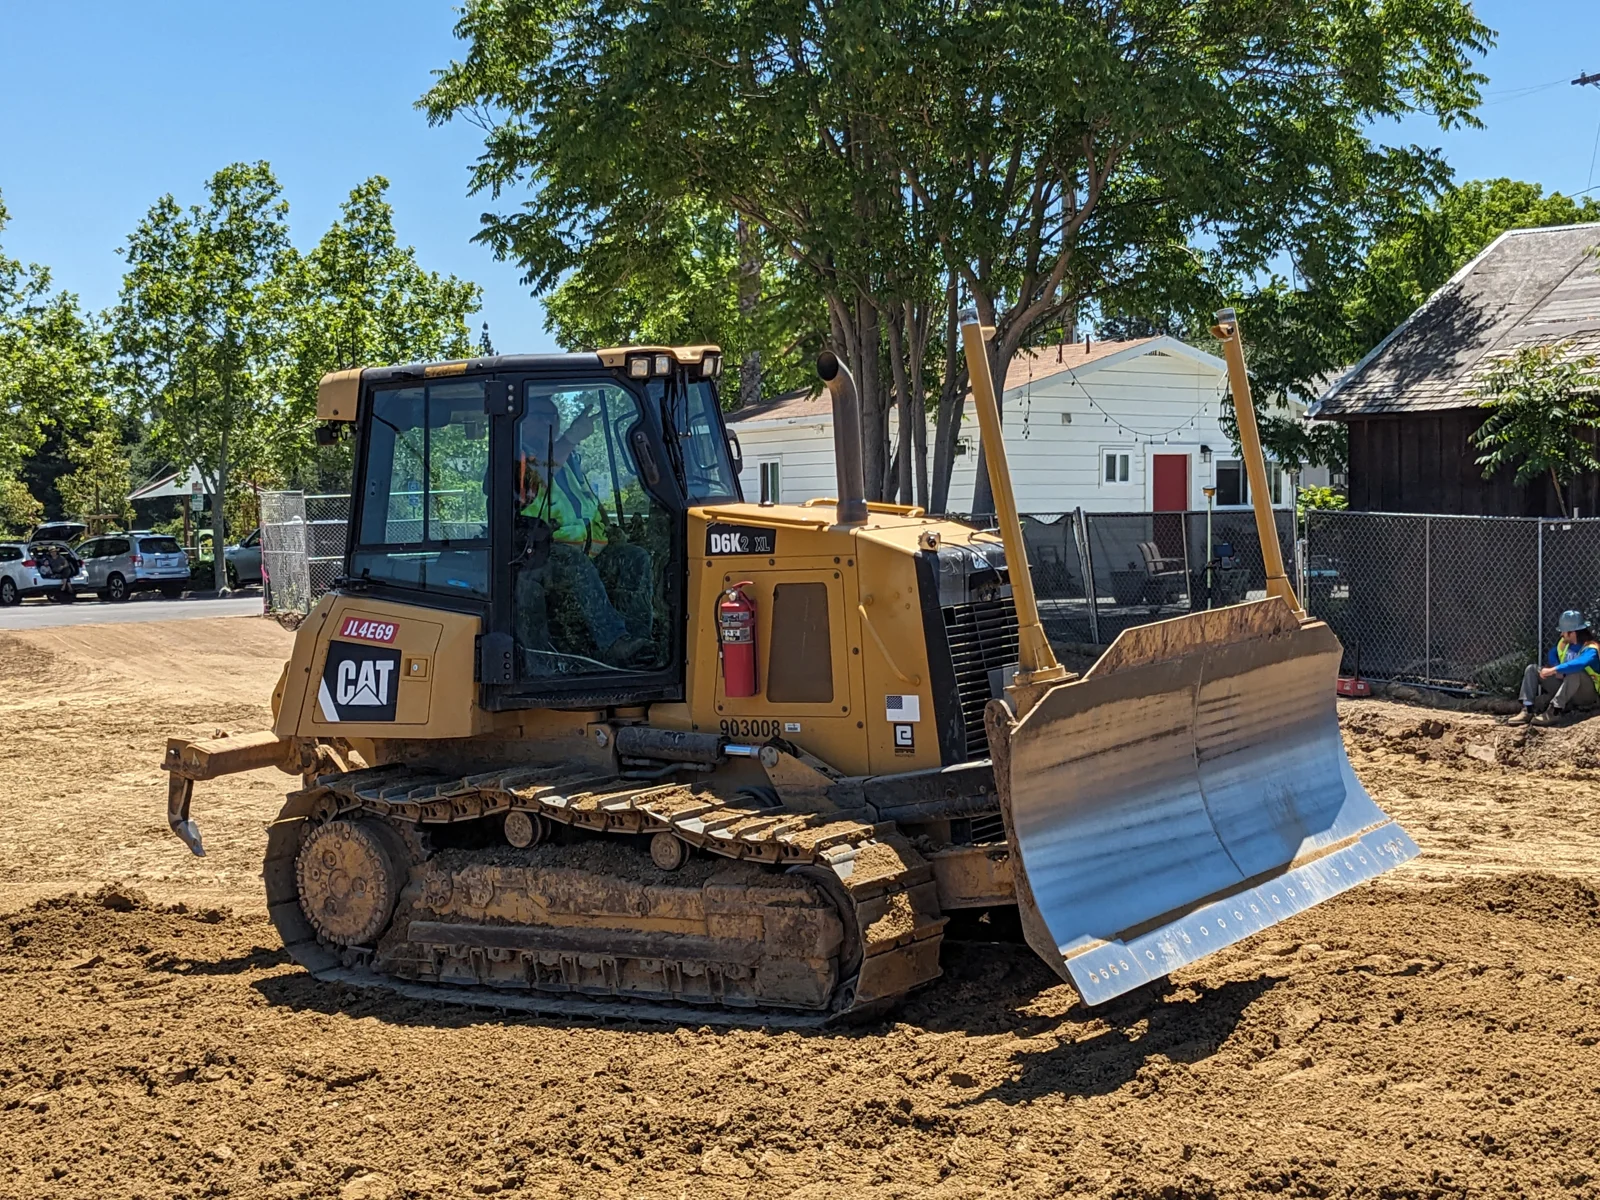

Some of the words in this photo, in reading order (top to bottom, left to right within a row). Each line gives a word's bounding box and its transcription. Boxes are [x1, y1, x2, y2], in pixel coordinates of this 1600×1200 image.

[754, 536, 770, 552] XL
[343, 620, 394, 641] JL4E69
[336, 660, 394, 706] CAT
[719, 719, 781, 737] 903008
